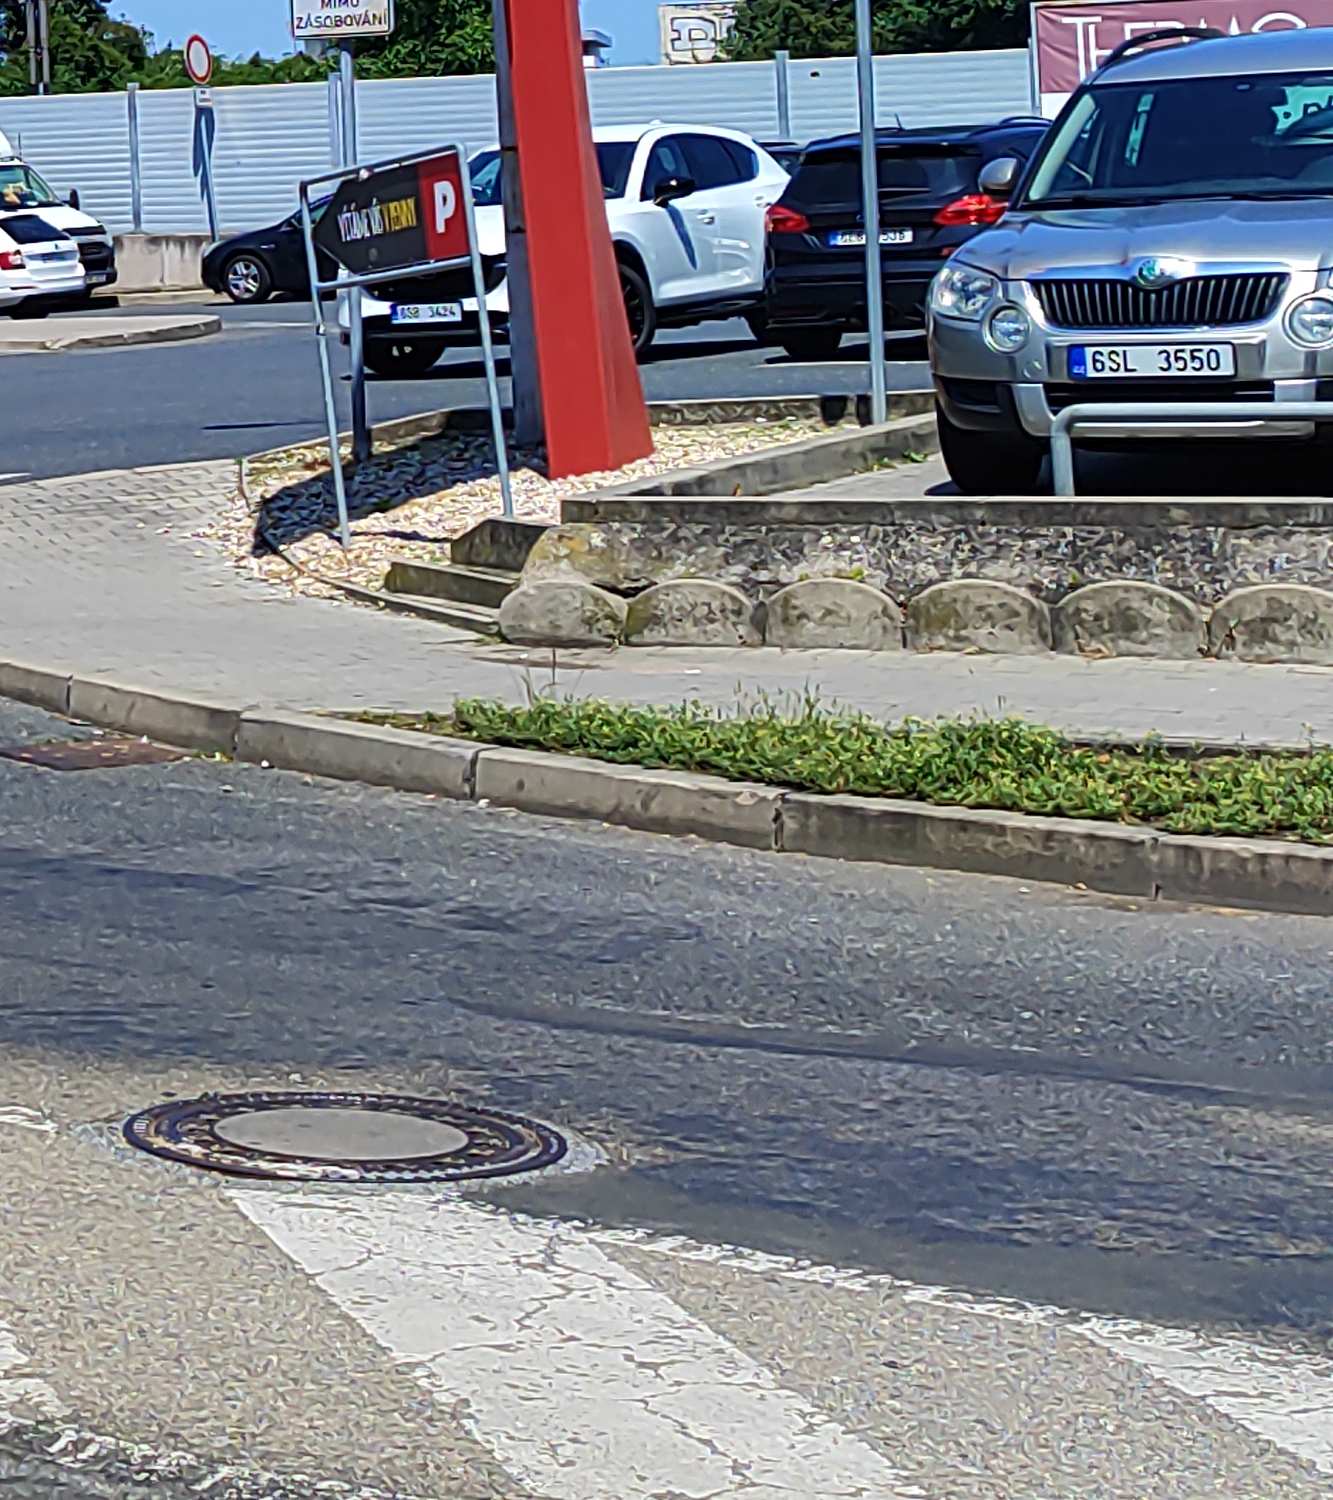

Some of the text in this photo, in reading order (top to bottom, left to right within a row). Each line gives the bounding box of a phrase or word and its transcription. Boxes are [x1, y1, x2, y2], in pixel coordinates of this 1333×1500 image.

[295, 8, 388, 30] ZÁSOBOVÁNÍ
[434, 180, 456, 234] P
[1092, 348, 1222, 373] 6SL 3550
